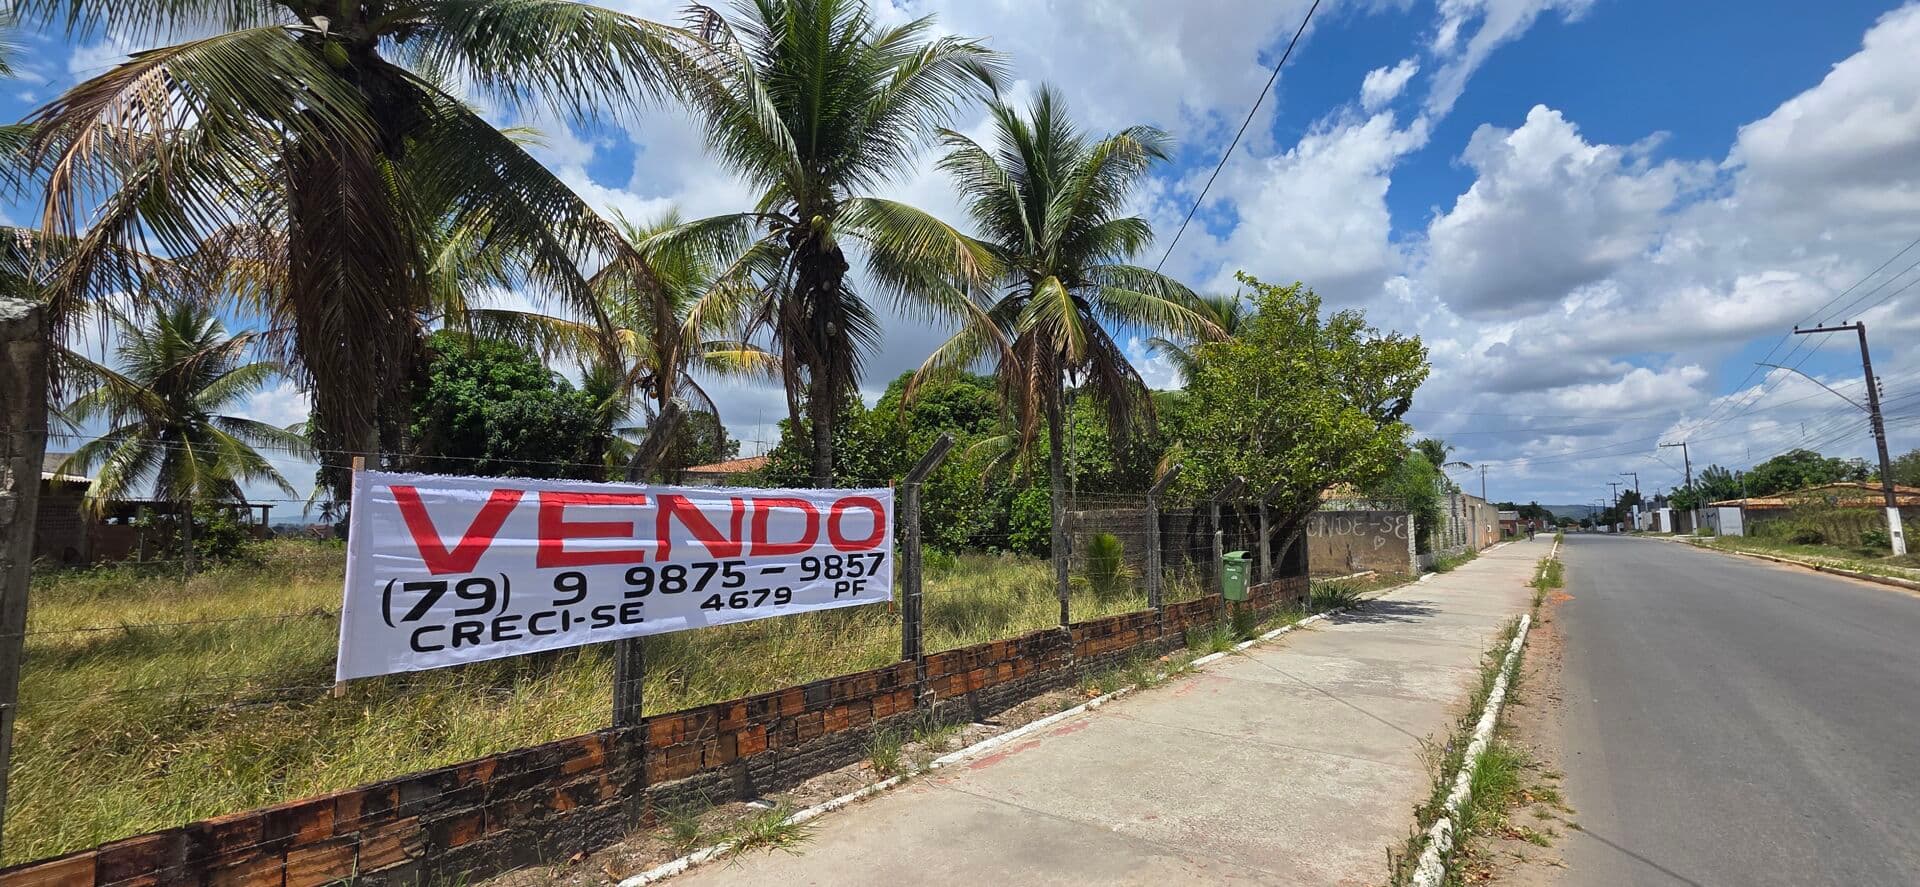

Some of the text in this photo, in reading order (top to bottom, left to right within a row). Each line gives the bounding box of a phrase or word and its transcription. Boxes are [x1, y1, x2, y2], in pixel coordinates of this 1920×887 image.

[390, 486, 886, 575] VENDO
[1306, 514, 1408, 540] ENDE-SE
[381, 572, 511, 628] (79)
[552, 571, 588, 607] 9
[623, 560, 747, 600] 9875
[799, 551, 885, 582] 9857
[409, 579, 868, 653] CRECI-SE 4679 PF
